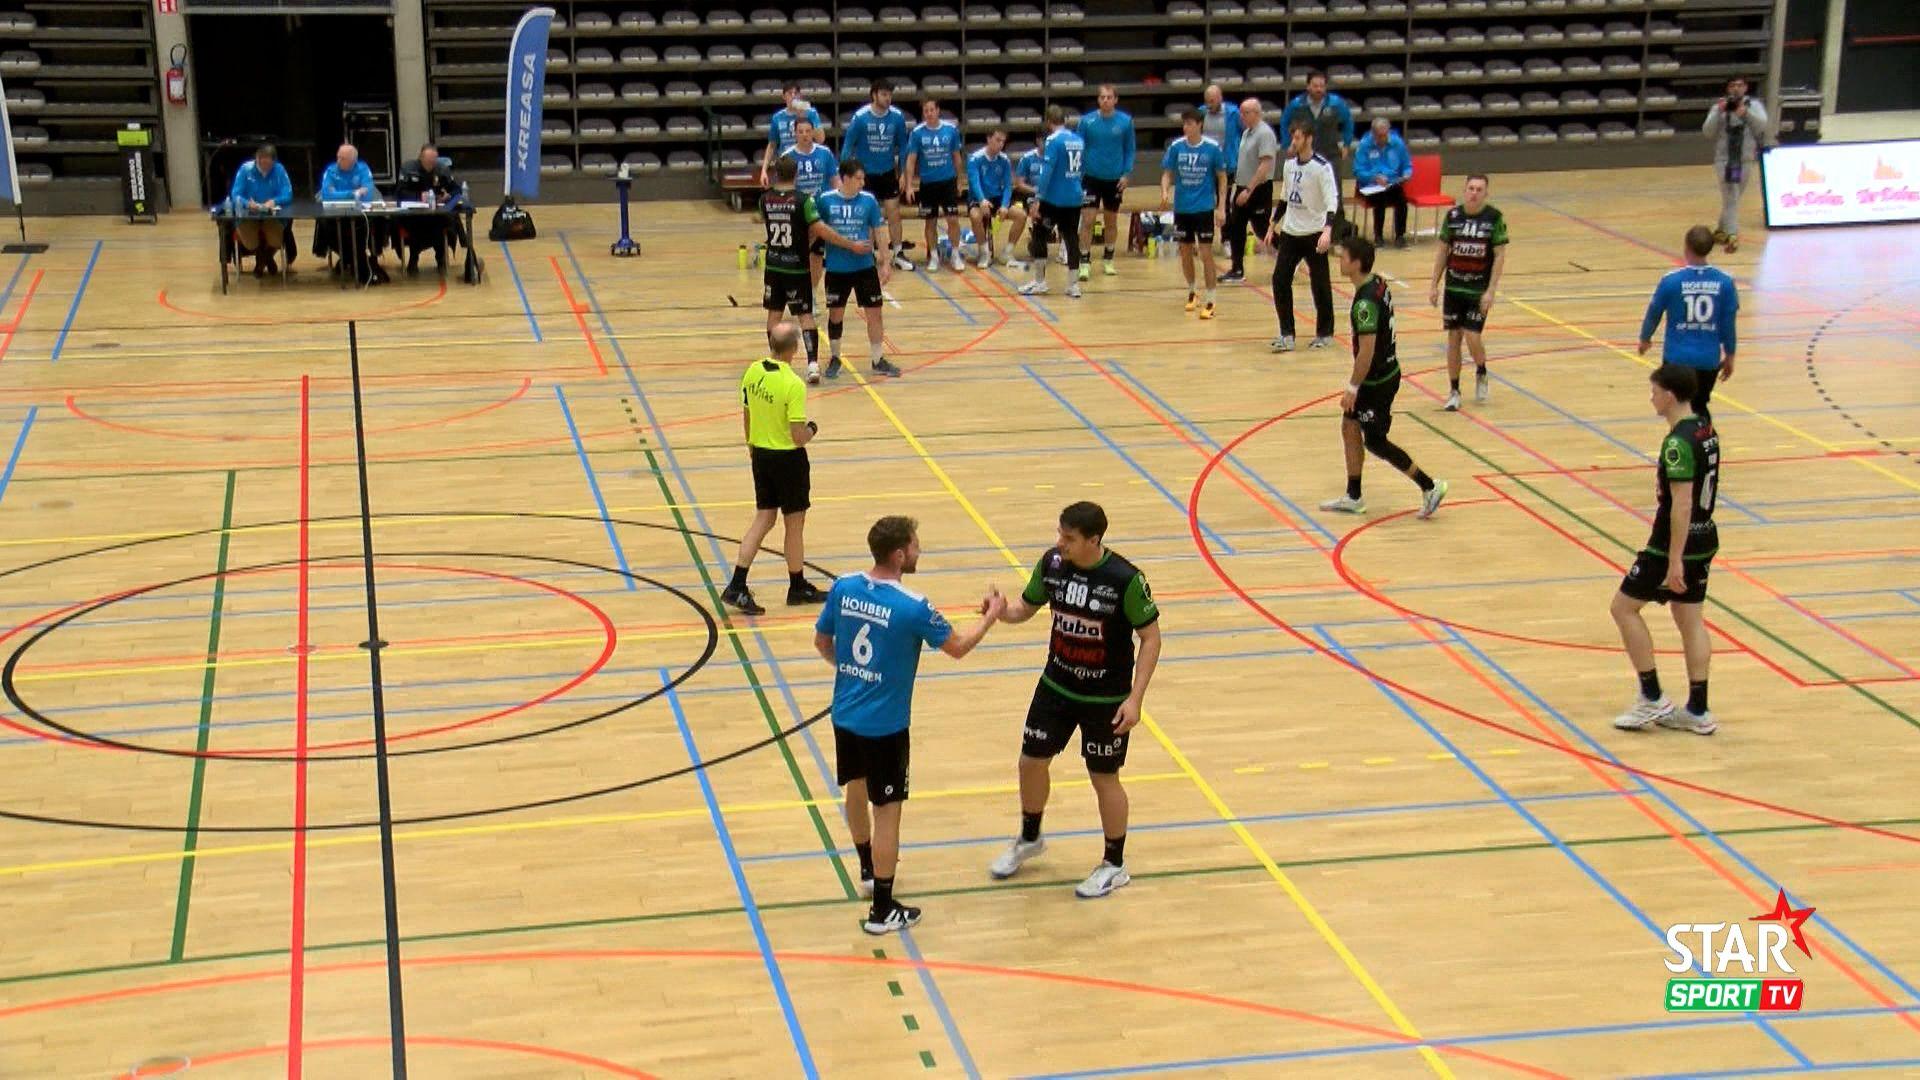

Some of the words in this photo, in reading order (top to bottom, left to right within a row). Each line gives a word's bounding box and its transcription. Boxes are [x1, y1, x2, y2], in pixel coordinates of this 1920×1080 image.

[518, 53, 536, 172] KREASA
[879, 123, 885, 135] 9
[933, 135, 940, 147] 4
[805, 160, 813, 173] 8
[1188, 153, 1198, 167] 17
[842, 205, 852, 219] 11
[769, 223, 793, 248] 23
[1462, 222, 1477, 237] 44
[1684, 294, 1713, 323] 10
[1065, 580, 1089, 609] 88
[841, 596, 892, 620] HOUBEN
[1054, 612, 1101, 637] Hubo
[852, 623, 873, 666] 6
[1086, 741, 1114, 757] CLB
